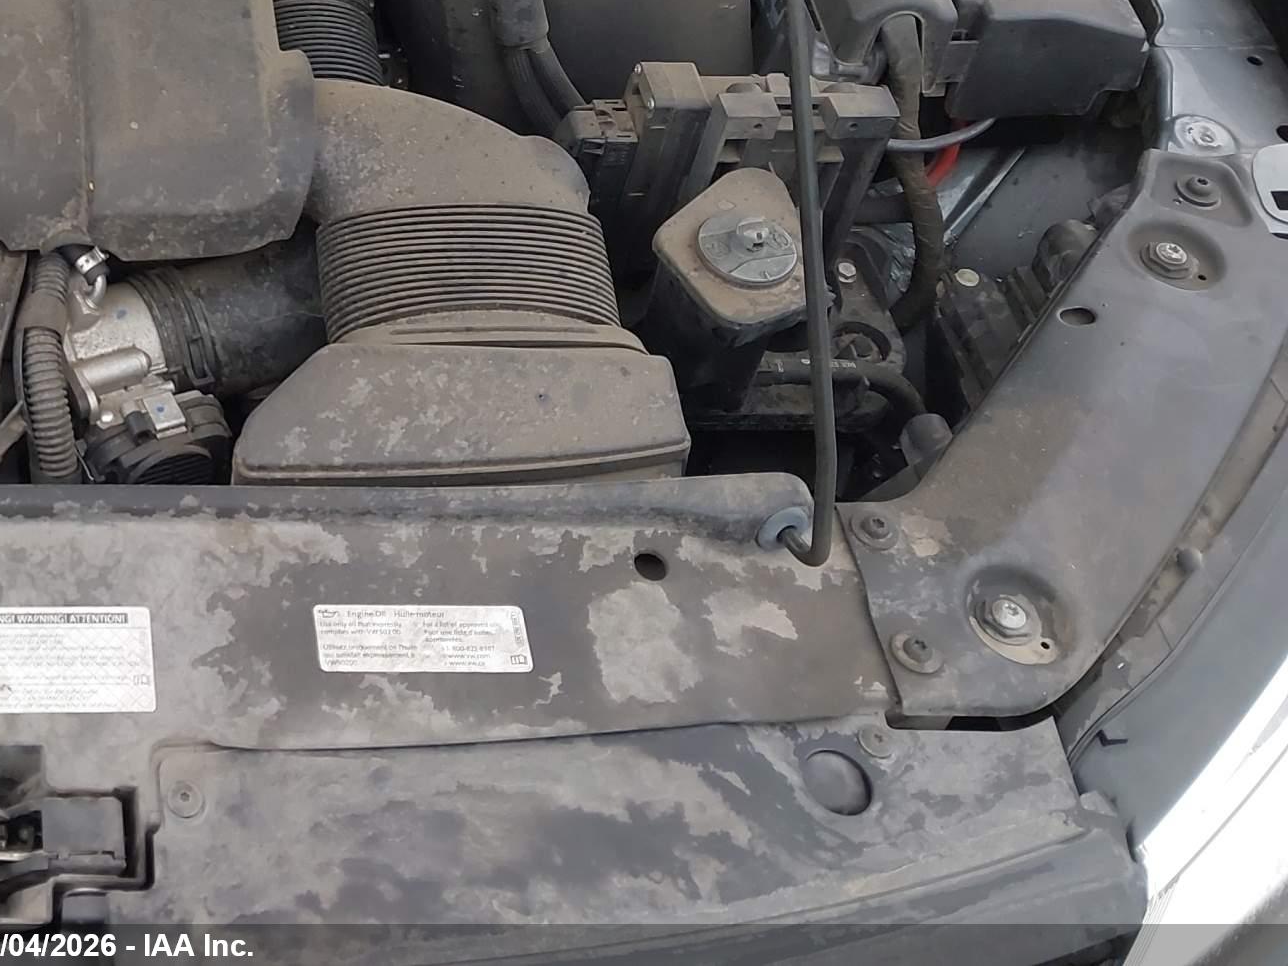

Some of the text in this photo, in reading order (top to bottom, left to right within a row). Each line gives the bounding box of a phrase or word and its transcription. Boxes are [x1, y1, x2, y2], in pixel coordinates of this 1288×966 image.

[17, 614, 67, 624] WARNING!
[69, 614, 125, 624] ATTENTION!
[348, 610, 374, 619] Engine
